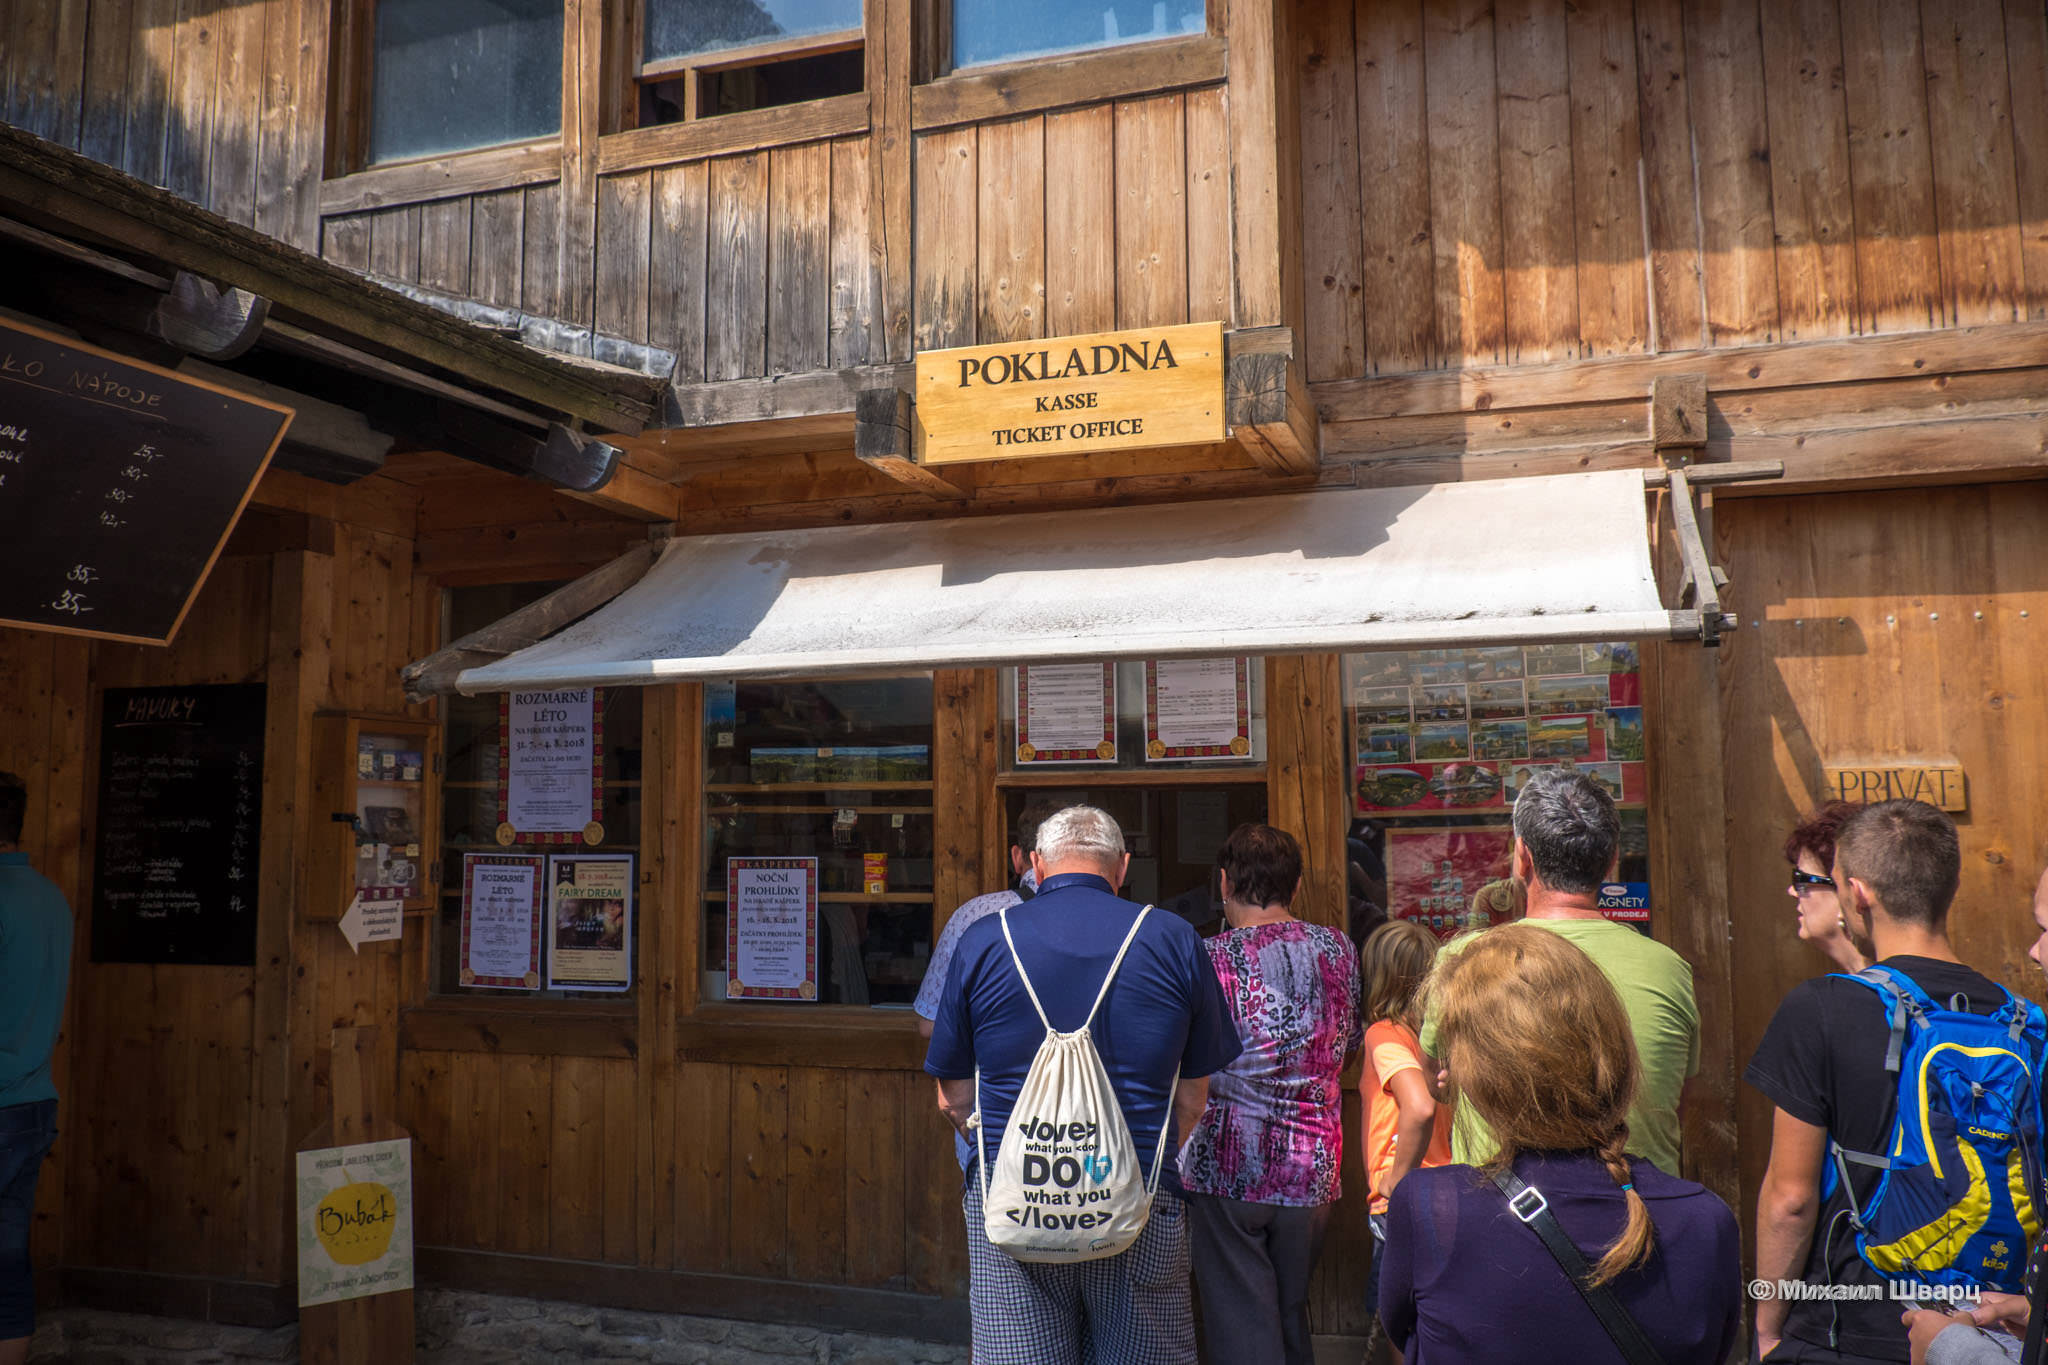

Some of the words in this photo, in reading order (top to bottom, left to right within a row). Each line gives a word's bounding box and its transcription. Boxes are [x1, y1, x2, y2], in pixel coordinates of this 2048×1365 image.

[958, 339, 1179, 388] POKLADNA
[1035, 392, 1098, 413] KASSE
[992, 424, 1066, 446] TICKET
[1070, 418, 1143, 439] OFFICE
[515, 689, 588, 705] ROZMARNÉ
[533, 708, 567, 722] LÉTO
[1839, 769, 1955, 806] PRIVAT
[755, 872, 789, 882] NOČNÍ
[559, 888, 584, 897] FAIRY
[587, 888, 622, 897] DREAM
[744, 885, 801, 895] PROHLÍDKY
[1026, 1143, 1051, 1153] what
[1053, 1145, 1072, 1155] you
[1023, 1154, 1081, 1188] DO
[1024, 1189, 1071, 1205] what
[1077, 1188, 1111, 1207] you
[319, 1194, 396, 1236] Bubák
[1006, 1206, 1113, 1230] </love>
